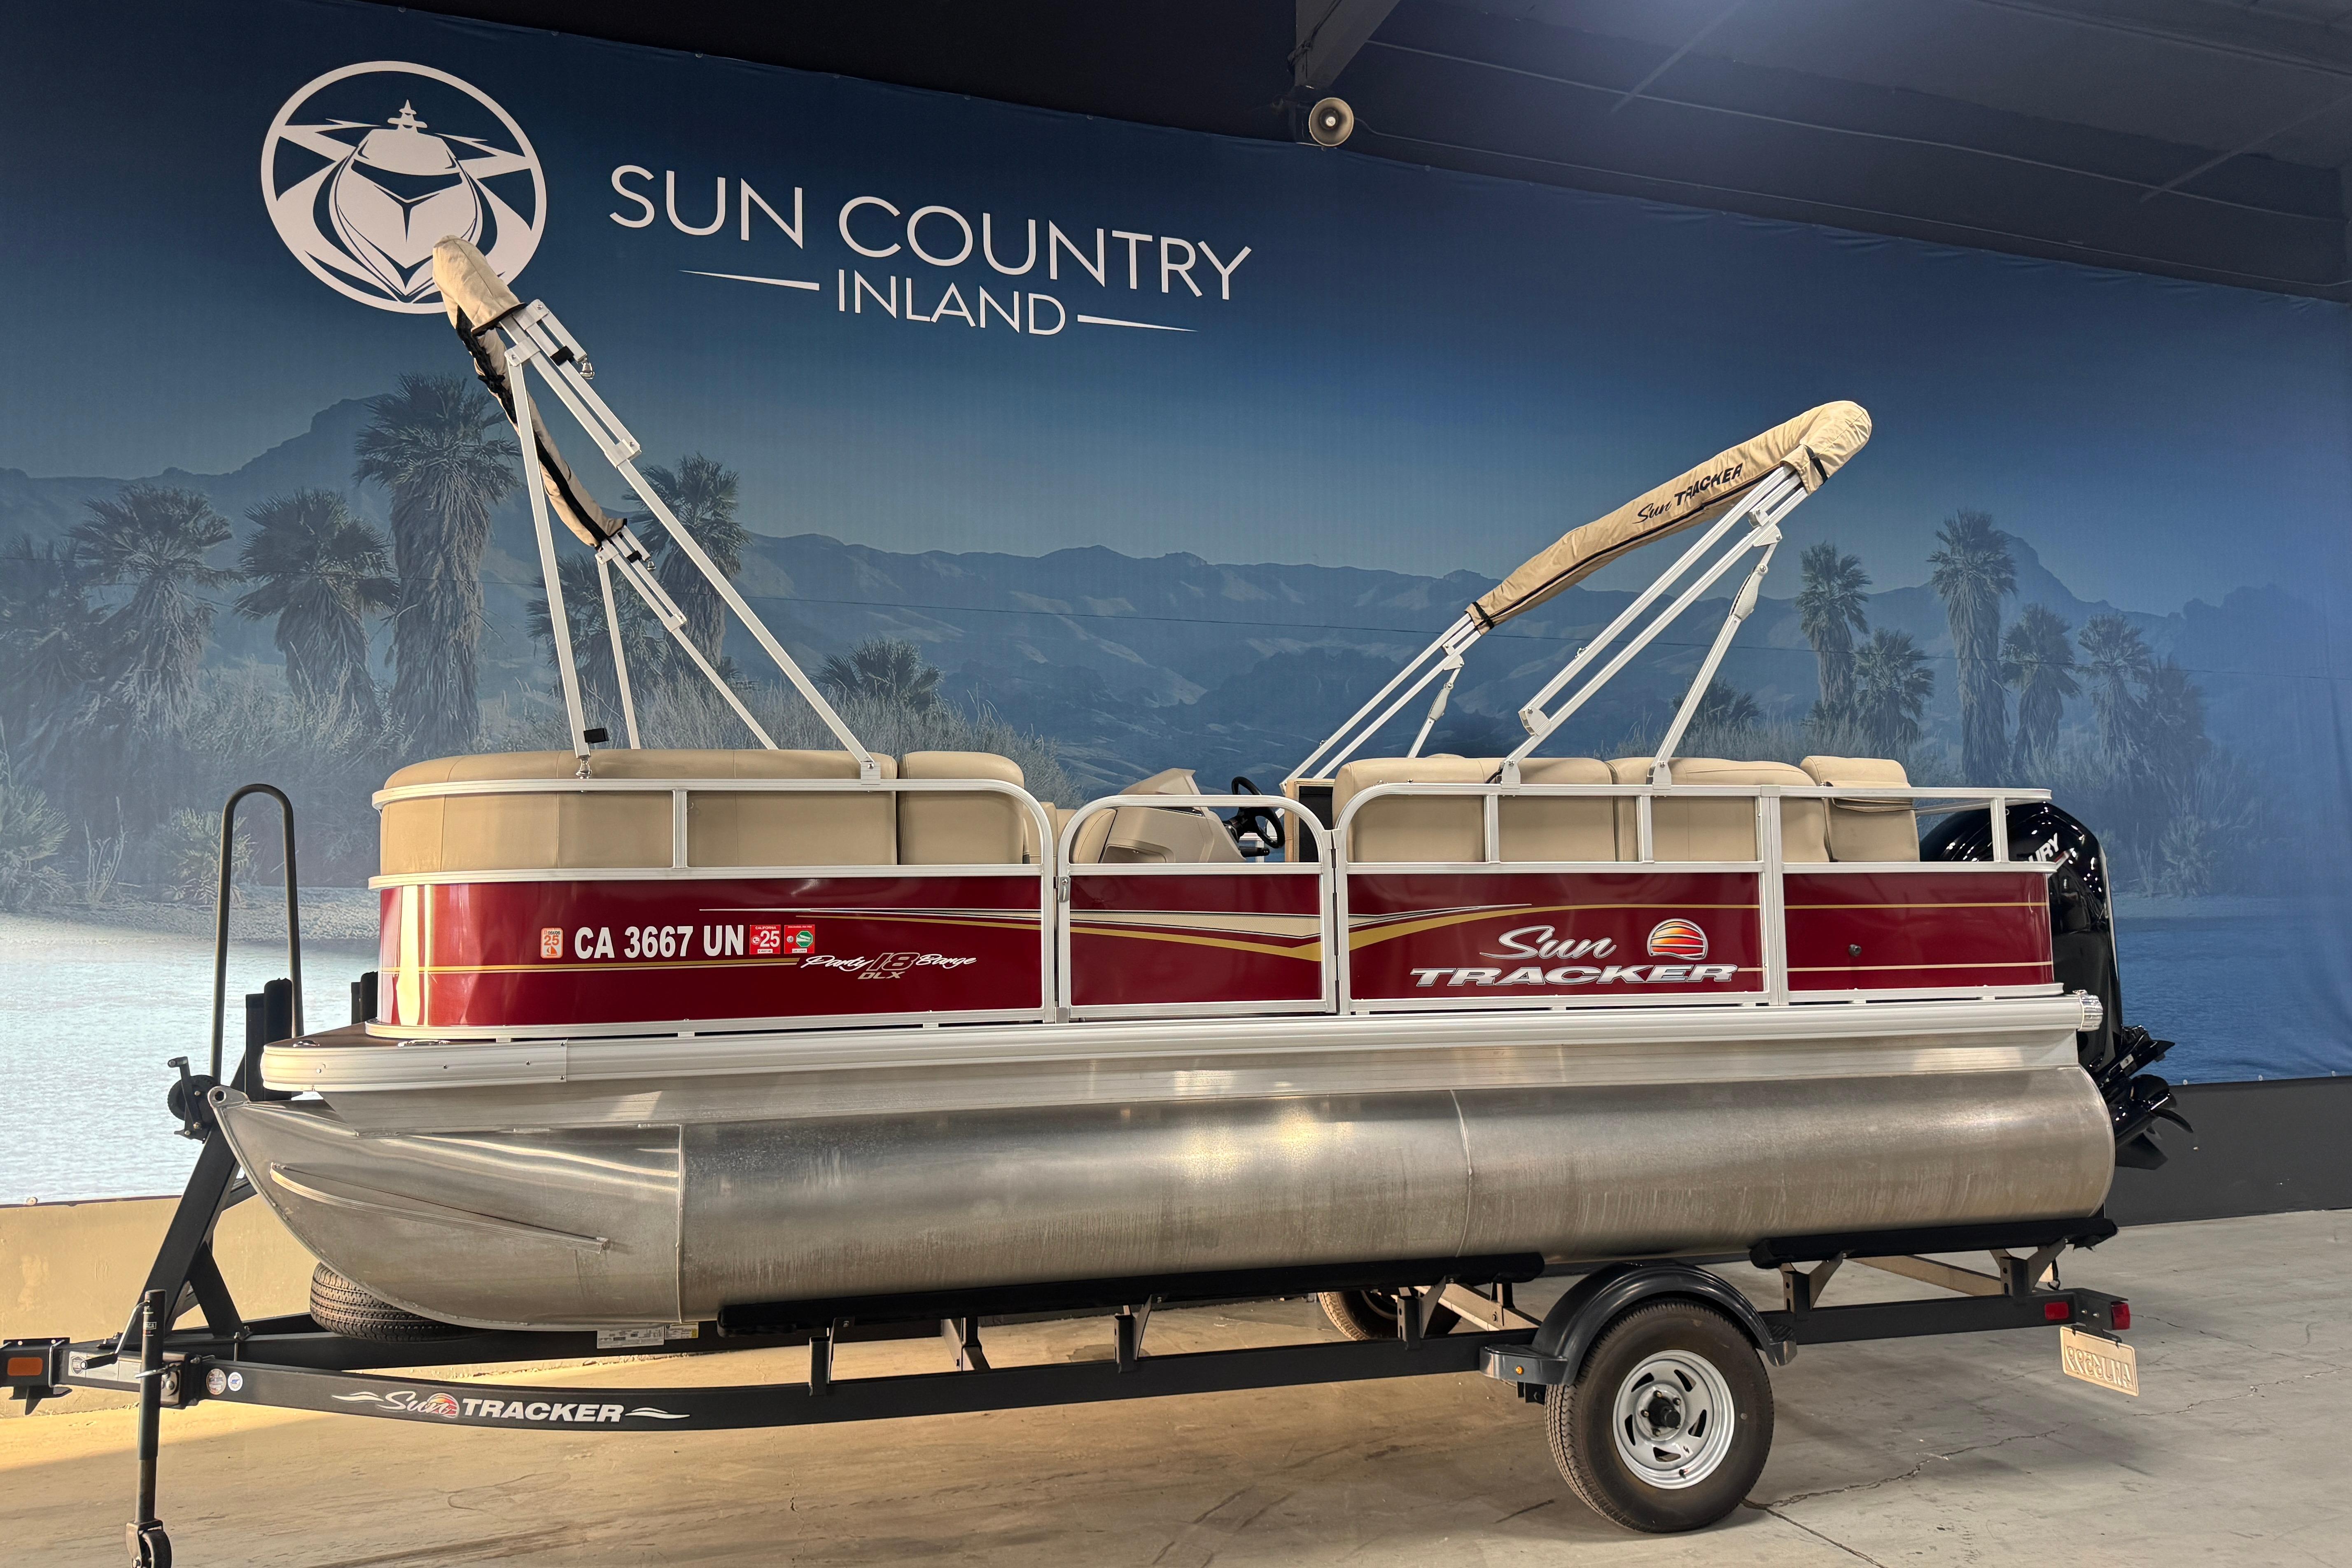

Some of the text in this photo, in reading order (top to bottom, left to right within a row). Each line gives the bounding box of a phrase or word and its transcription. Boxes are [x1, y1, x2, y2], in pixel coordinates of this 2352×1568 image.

[609, 165, 1251, 301] SUN COUNTRY
[838, 269, 1066, 335] INLAND
[1632, 462, 1743, 524] Sun TRACKER
[544, 935, 560, 945] 25
[574, 925, 744, 959] CA 3667 UN
[760, 930, 780, 947] 25
[1479, 925, 1617, 960] Sun
[800, 952, 977, 972] Party 18 Barge
[858, 971, 905, 980] DLX
[1410, 964, 1738, 987] TRACKER
[377, 1391, 625, 1423] Sun TRACKER
